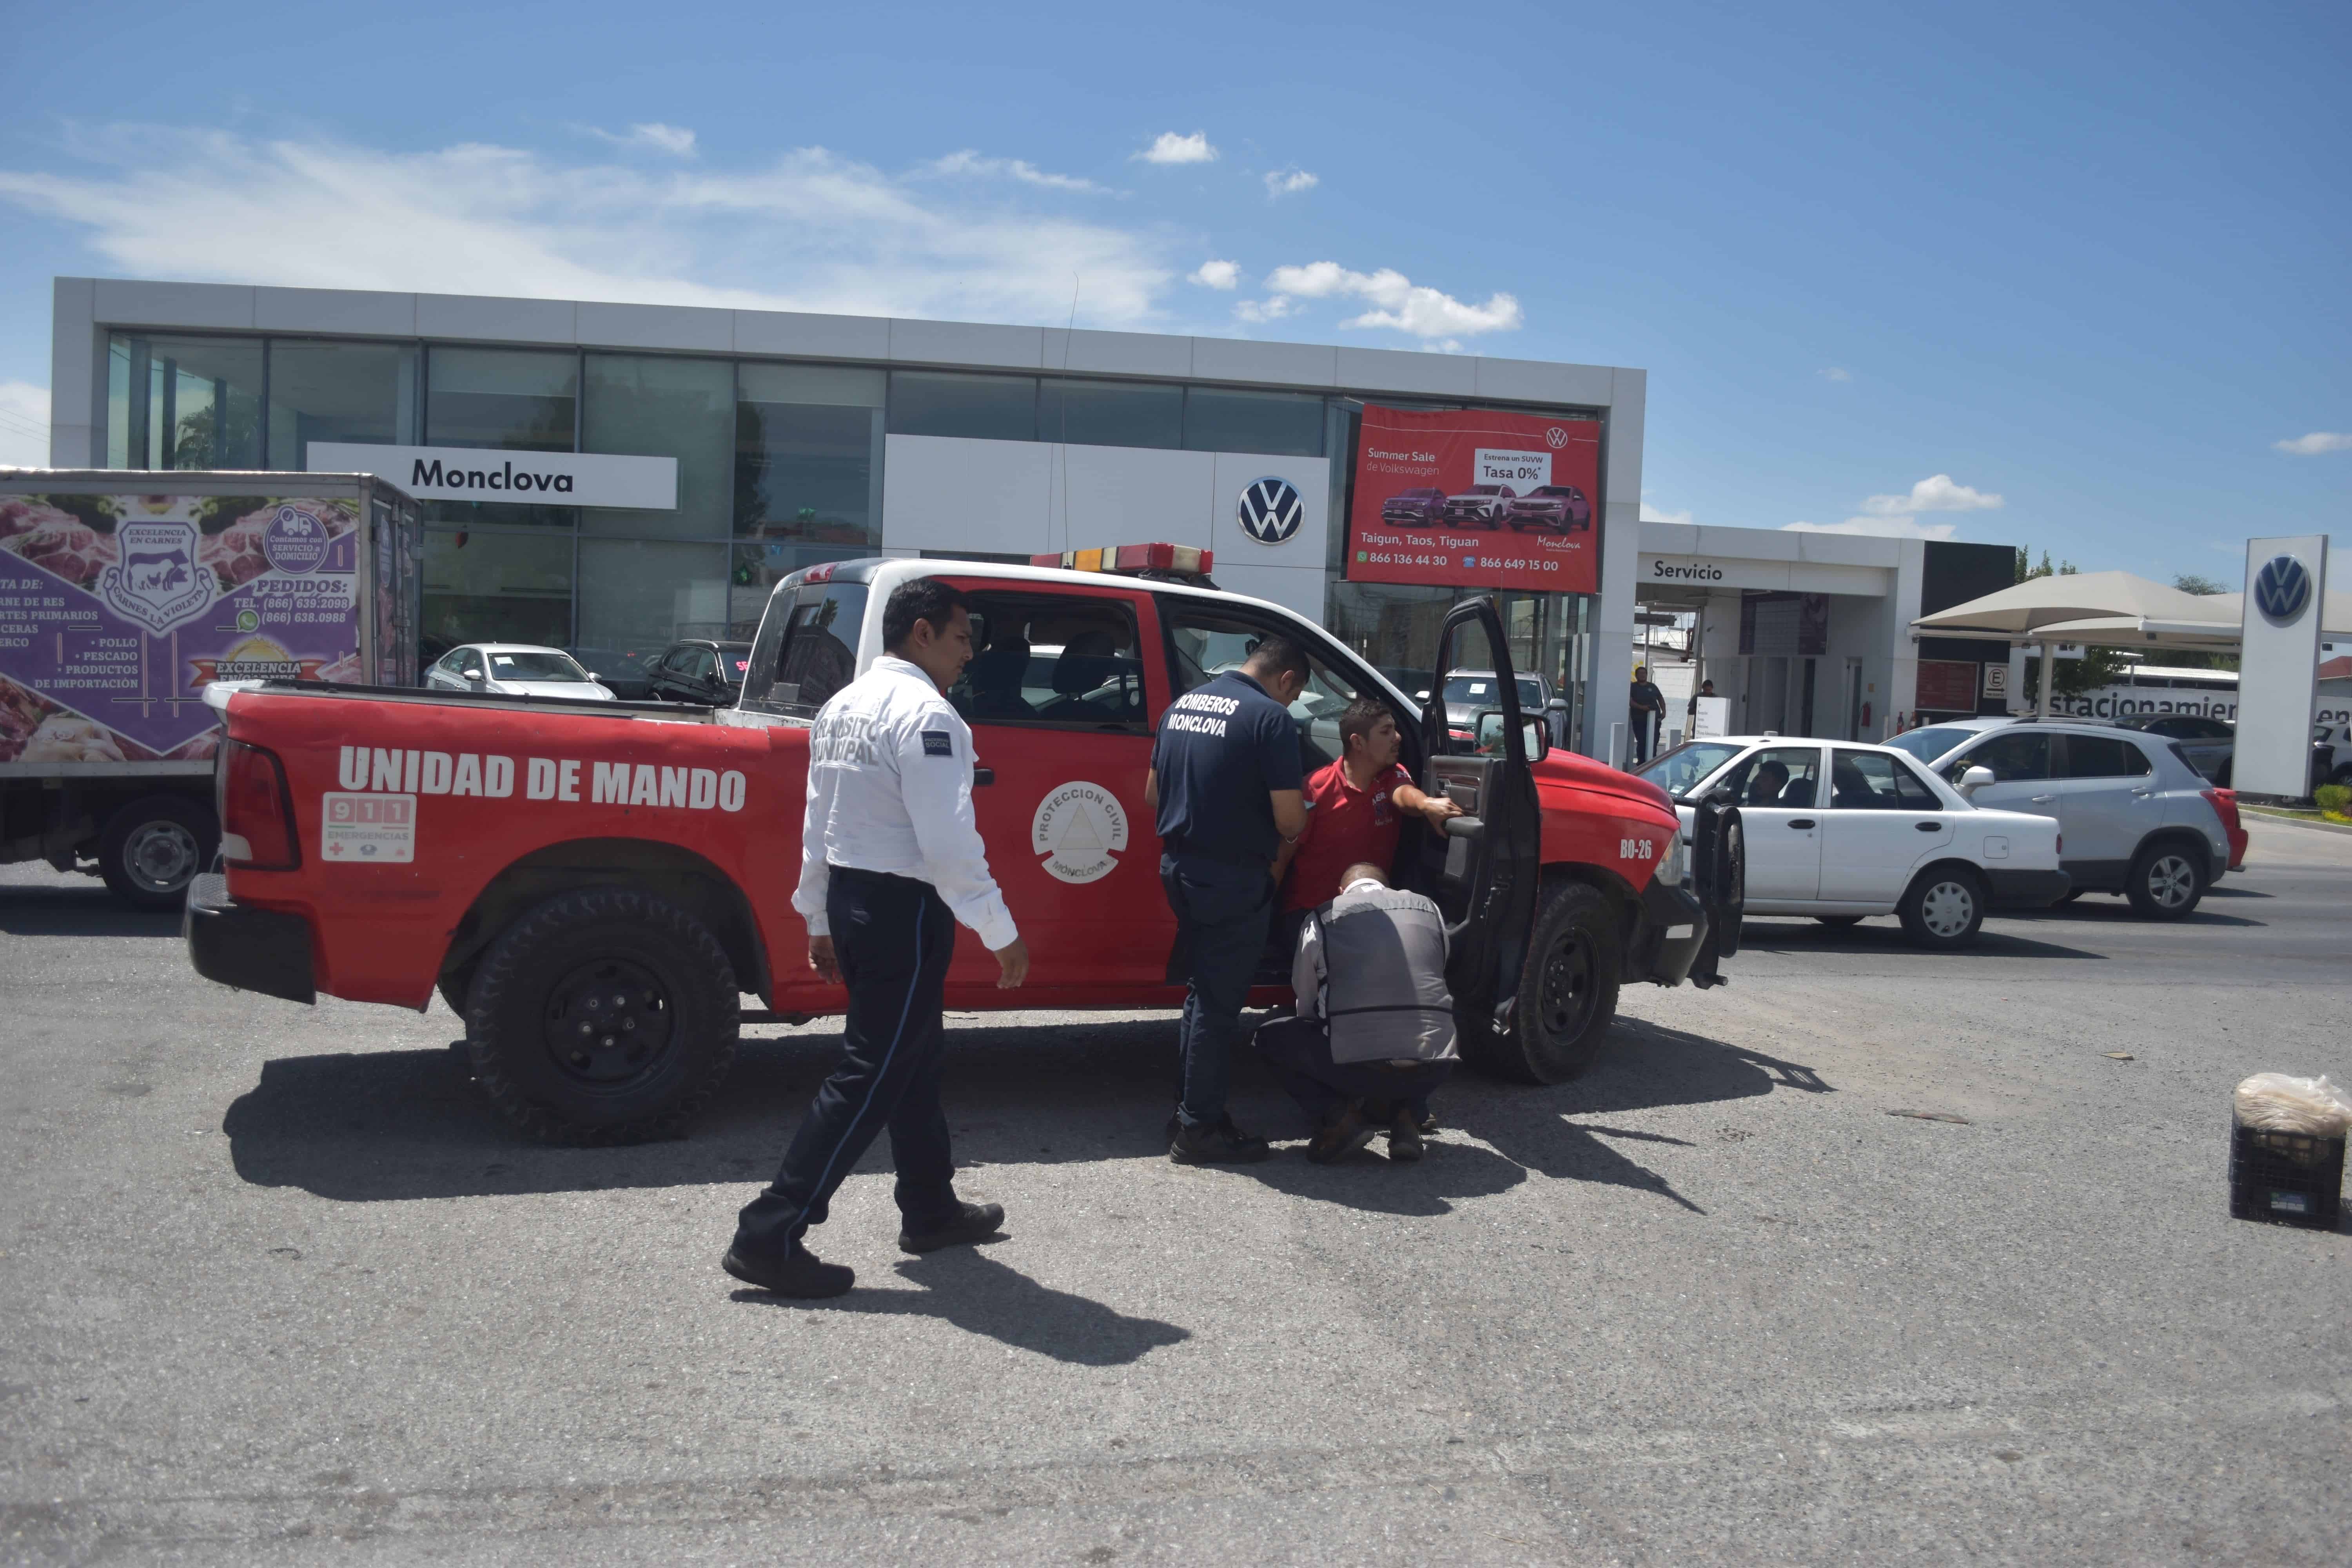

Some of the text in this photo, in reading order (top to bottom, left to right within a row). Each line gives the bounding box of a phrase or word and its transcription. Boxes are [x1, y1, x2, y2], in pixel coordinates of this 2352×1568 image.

[1368, 448, 1435, 461] Summer Sale
[412, 459, 573, 492] Monclova
[1367, 461, 1439, 477] de Volkswagen
[1483, 466, 1514, 479] Tasa
[1361, 532, 1479, 549] Taigun, Taos, Tiguan
[1537, 535, 1581, 549] Monclova
[1370, 552, 1447, 566] 866 136 44 30
[1480, 557, 1558, 571] 866 649 15 00
[1653, 560, 1722, 581] Servicio
[22, 579, 44, 589] DE:
[256, 580, 347, 593] PEDIDOS:
[24, 598, 40, 606] DE
[43, 598, 65, 606] RES
[114, 586, 204, 624] CARNES LA VIOLETA
[234, 598, 259, 608] TEL.
[264, 598, 292, 610] (866)
[31, 611, 98, 620] PRIMARIOS
[262, 613, 346, 625] (866) 638.0988
[99, 639, 138, 647] POLLO
[83, 652, 138, 661] PESCADO
[66, 666, 138, 674] PRODUCTOS
[216, 662, 301, 673] EXCELENCIA
[35, 678, 138, 688] DE IMPORTACIÓN
[1992, 672, 2000, 684] E
[1175, 694, 1239, 715] BOMBEROS
[815, 716, 877, 742] RANSITO
[1167, 714, 1226, 737] MONCLOVA
[339, 746, 746, 812] UNIDAD DE MANDO
[1039, 789, 1121, 841] PROTECCION CIVIL
[328, 831, 408, 840] EMERGENCIAS
[1053, 860, 1107, 877] MONCLOVA
